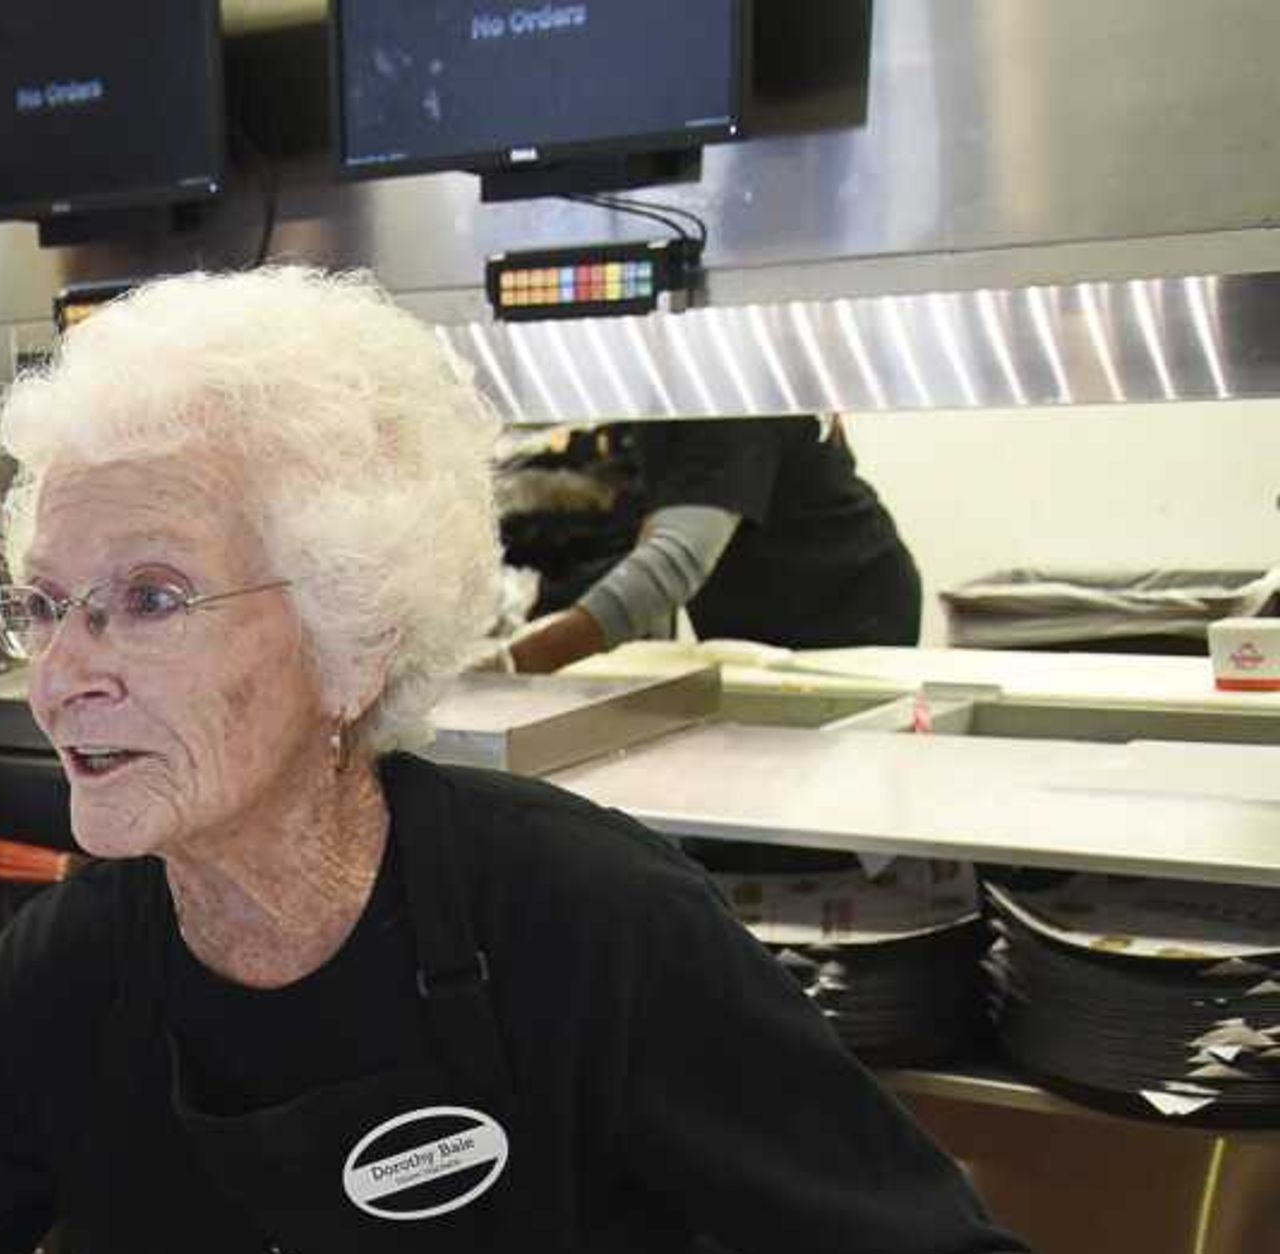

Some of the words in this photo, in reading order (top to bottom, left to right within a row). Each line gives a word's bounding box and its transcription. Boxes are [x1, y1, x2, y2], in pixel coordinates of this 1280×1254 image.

[471, 14, 503, 40] No
[509, 4, 587, 33] Orders
[370, 1150, 435, 1182] Dorothy
[437, 1136, 476, 1157] Bale
